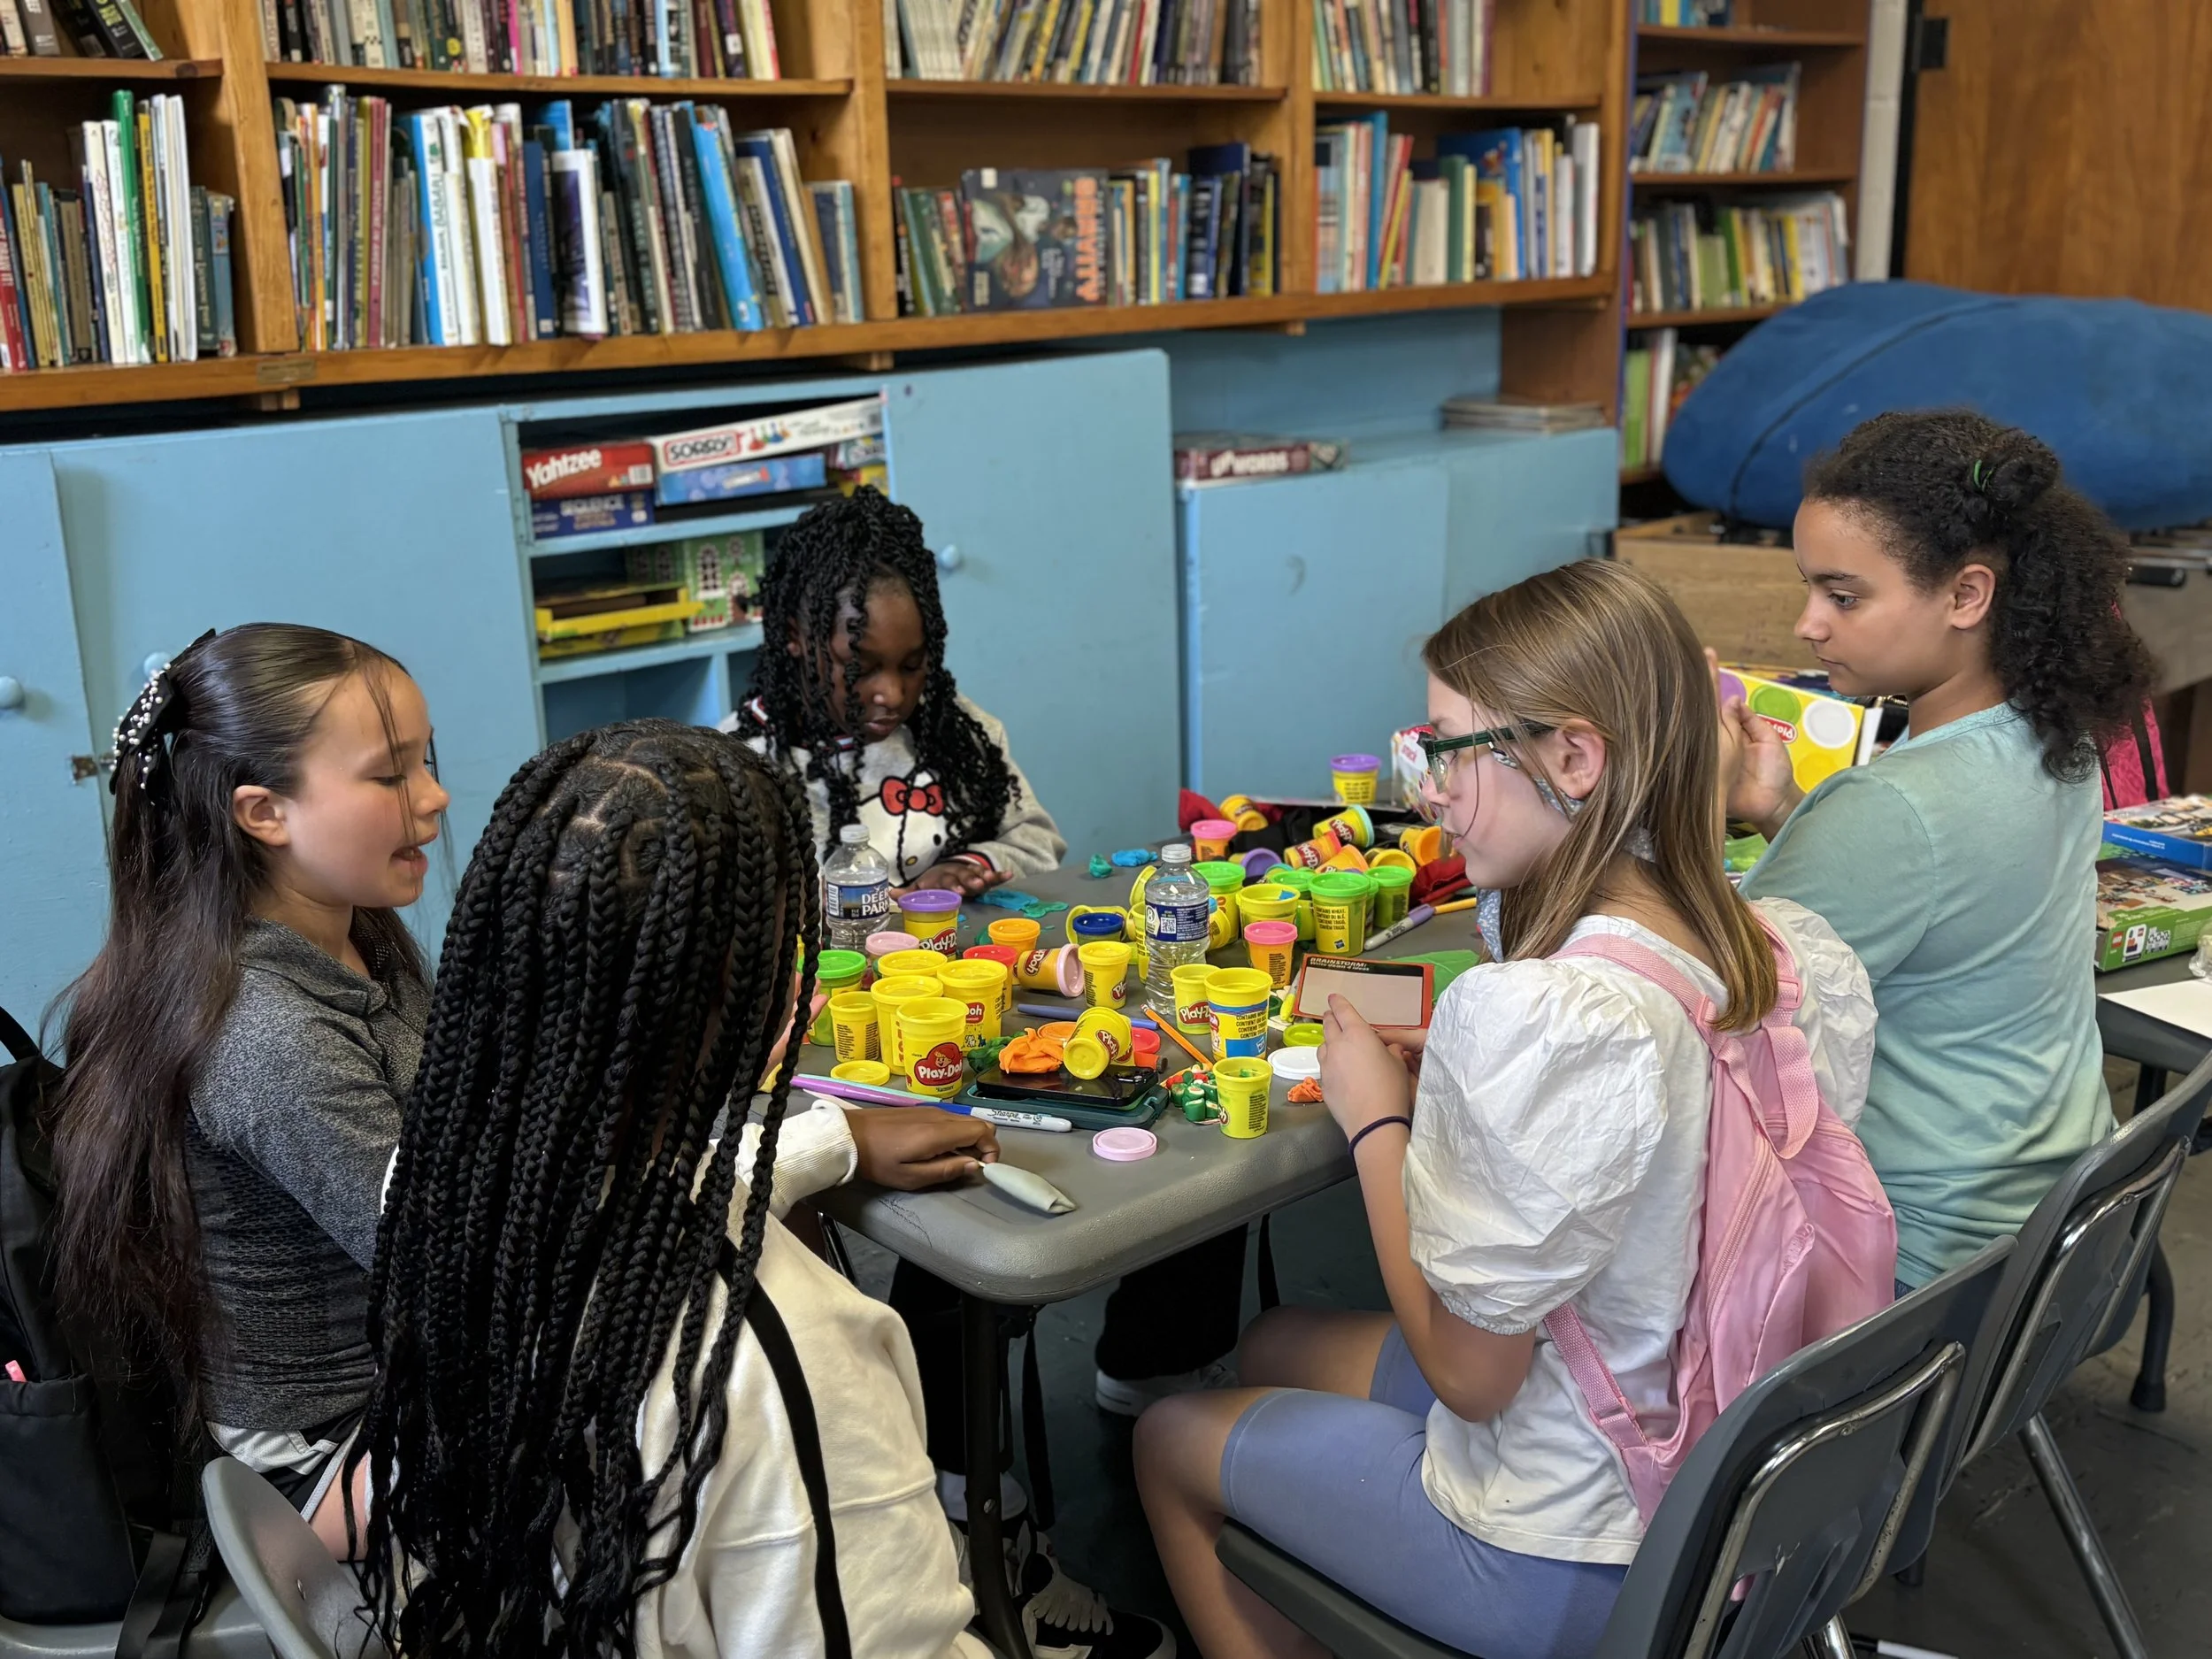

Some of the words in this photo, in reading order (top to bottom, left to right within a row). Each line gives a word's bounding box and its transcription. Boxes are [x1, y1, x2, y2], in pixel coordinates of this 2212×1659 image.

[526, 449, 603, 489] Yahtzee
[1332, 819, 1353, 841] Play-D
[1297, 842, 1319, 867] Play-D
[919, 932, 957, 951] Play-D
[1310, 957, 1367, 968] BRAINSTORM!
[1179, 1005, 1210, 1022] Play-
